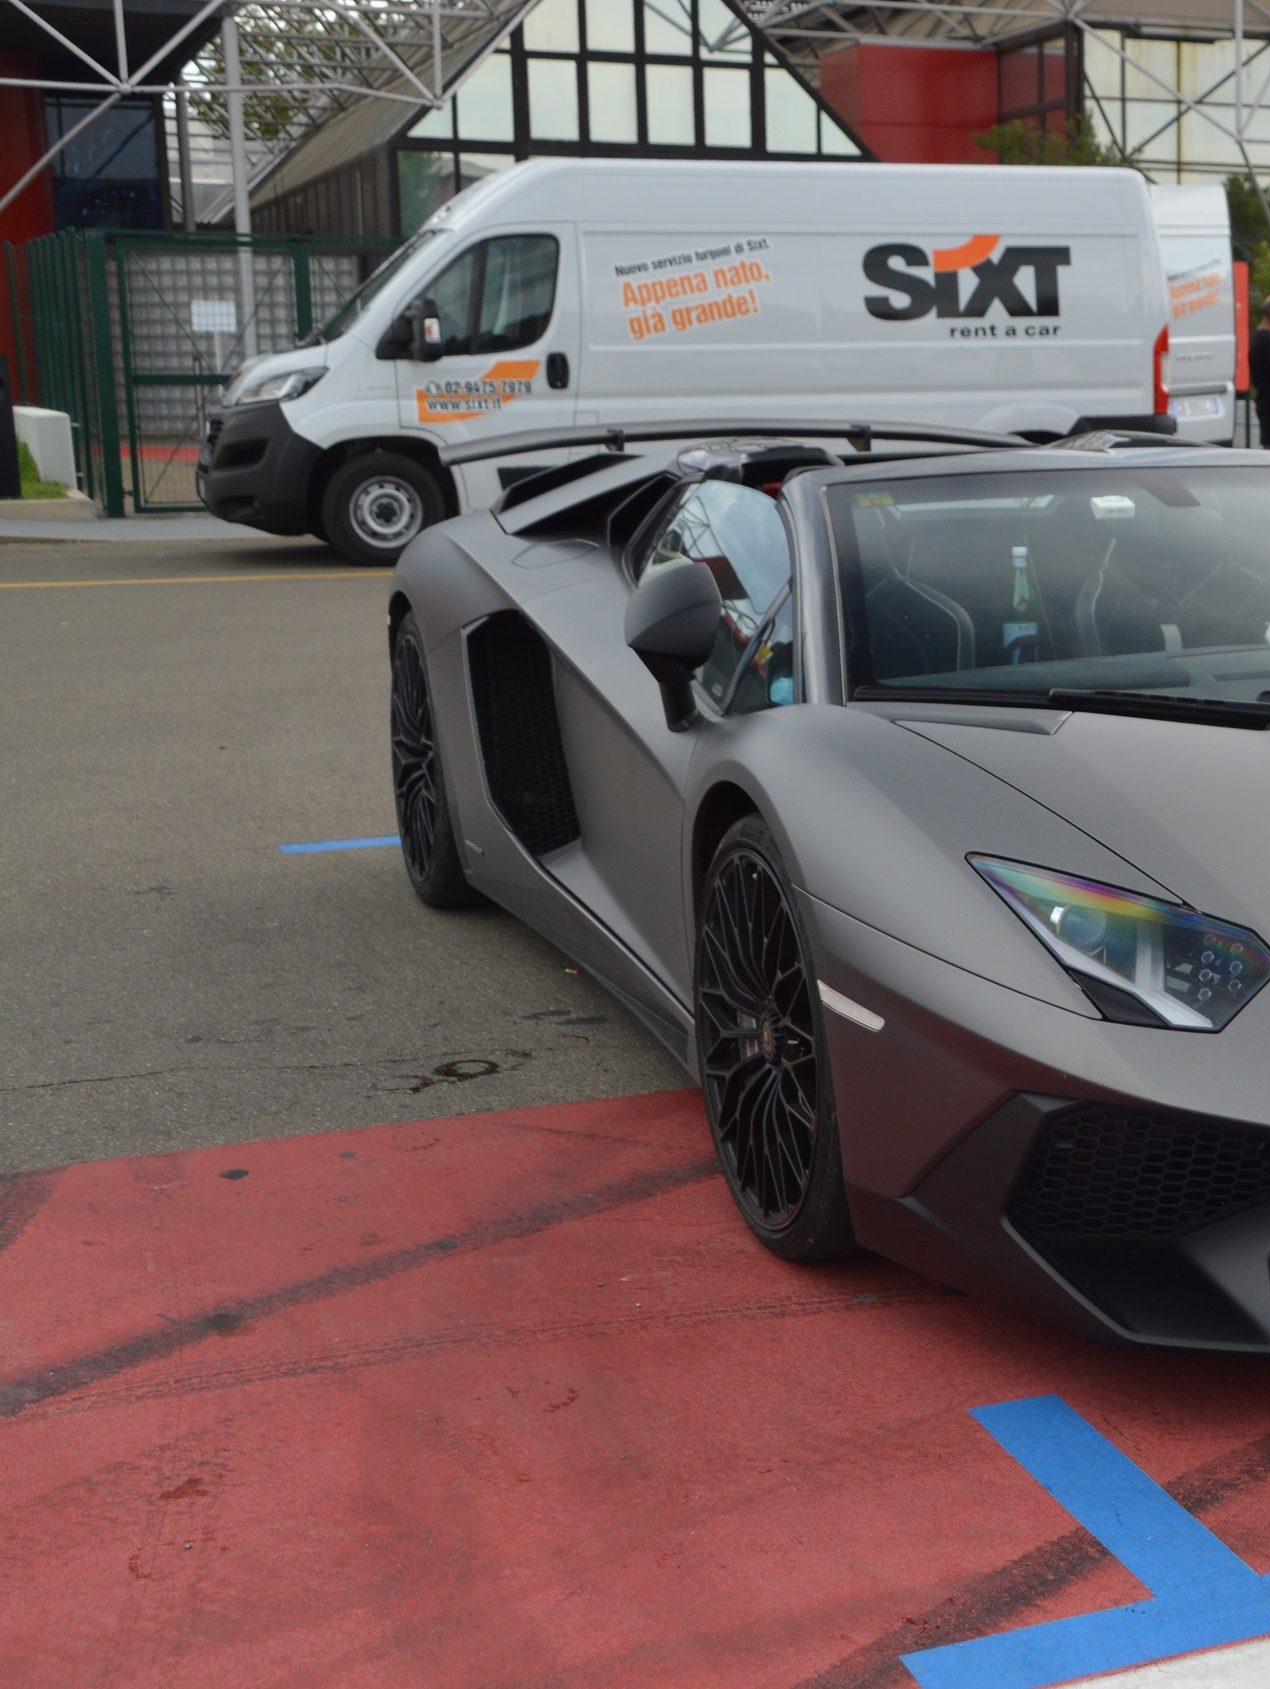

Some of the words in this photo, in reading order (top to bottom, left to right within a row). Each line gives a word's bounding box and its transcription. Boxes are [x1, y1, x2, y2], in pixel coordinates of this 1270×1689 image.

[614, 261, 649, 277] Nuovo
[651, 253, 693, 270] servizio
[734, 240, 745, 254] di
[622, 271, 709, 308] Appena
[712, 259, 771, 290] nato,
[628, 306, 667, 341] già
[670, 288, 760, 333] grande!
[950, 324, 998, 338] rent
[1005, 327, 1017, 337] a
[1025, 324, 1061, 338] car
[444, 380, 461, 394] 02
[465, 380, 497, 395] 9475
[502, 379, 532, 395] 7979
[426, 396, 502, 411] www.sixt.it
